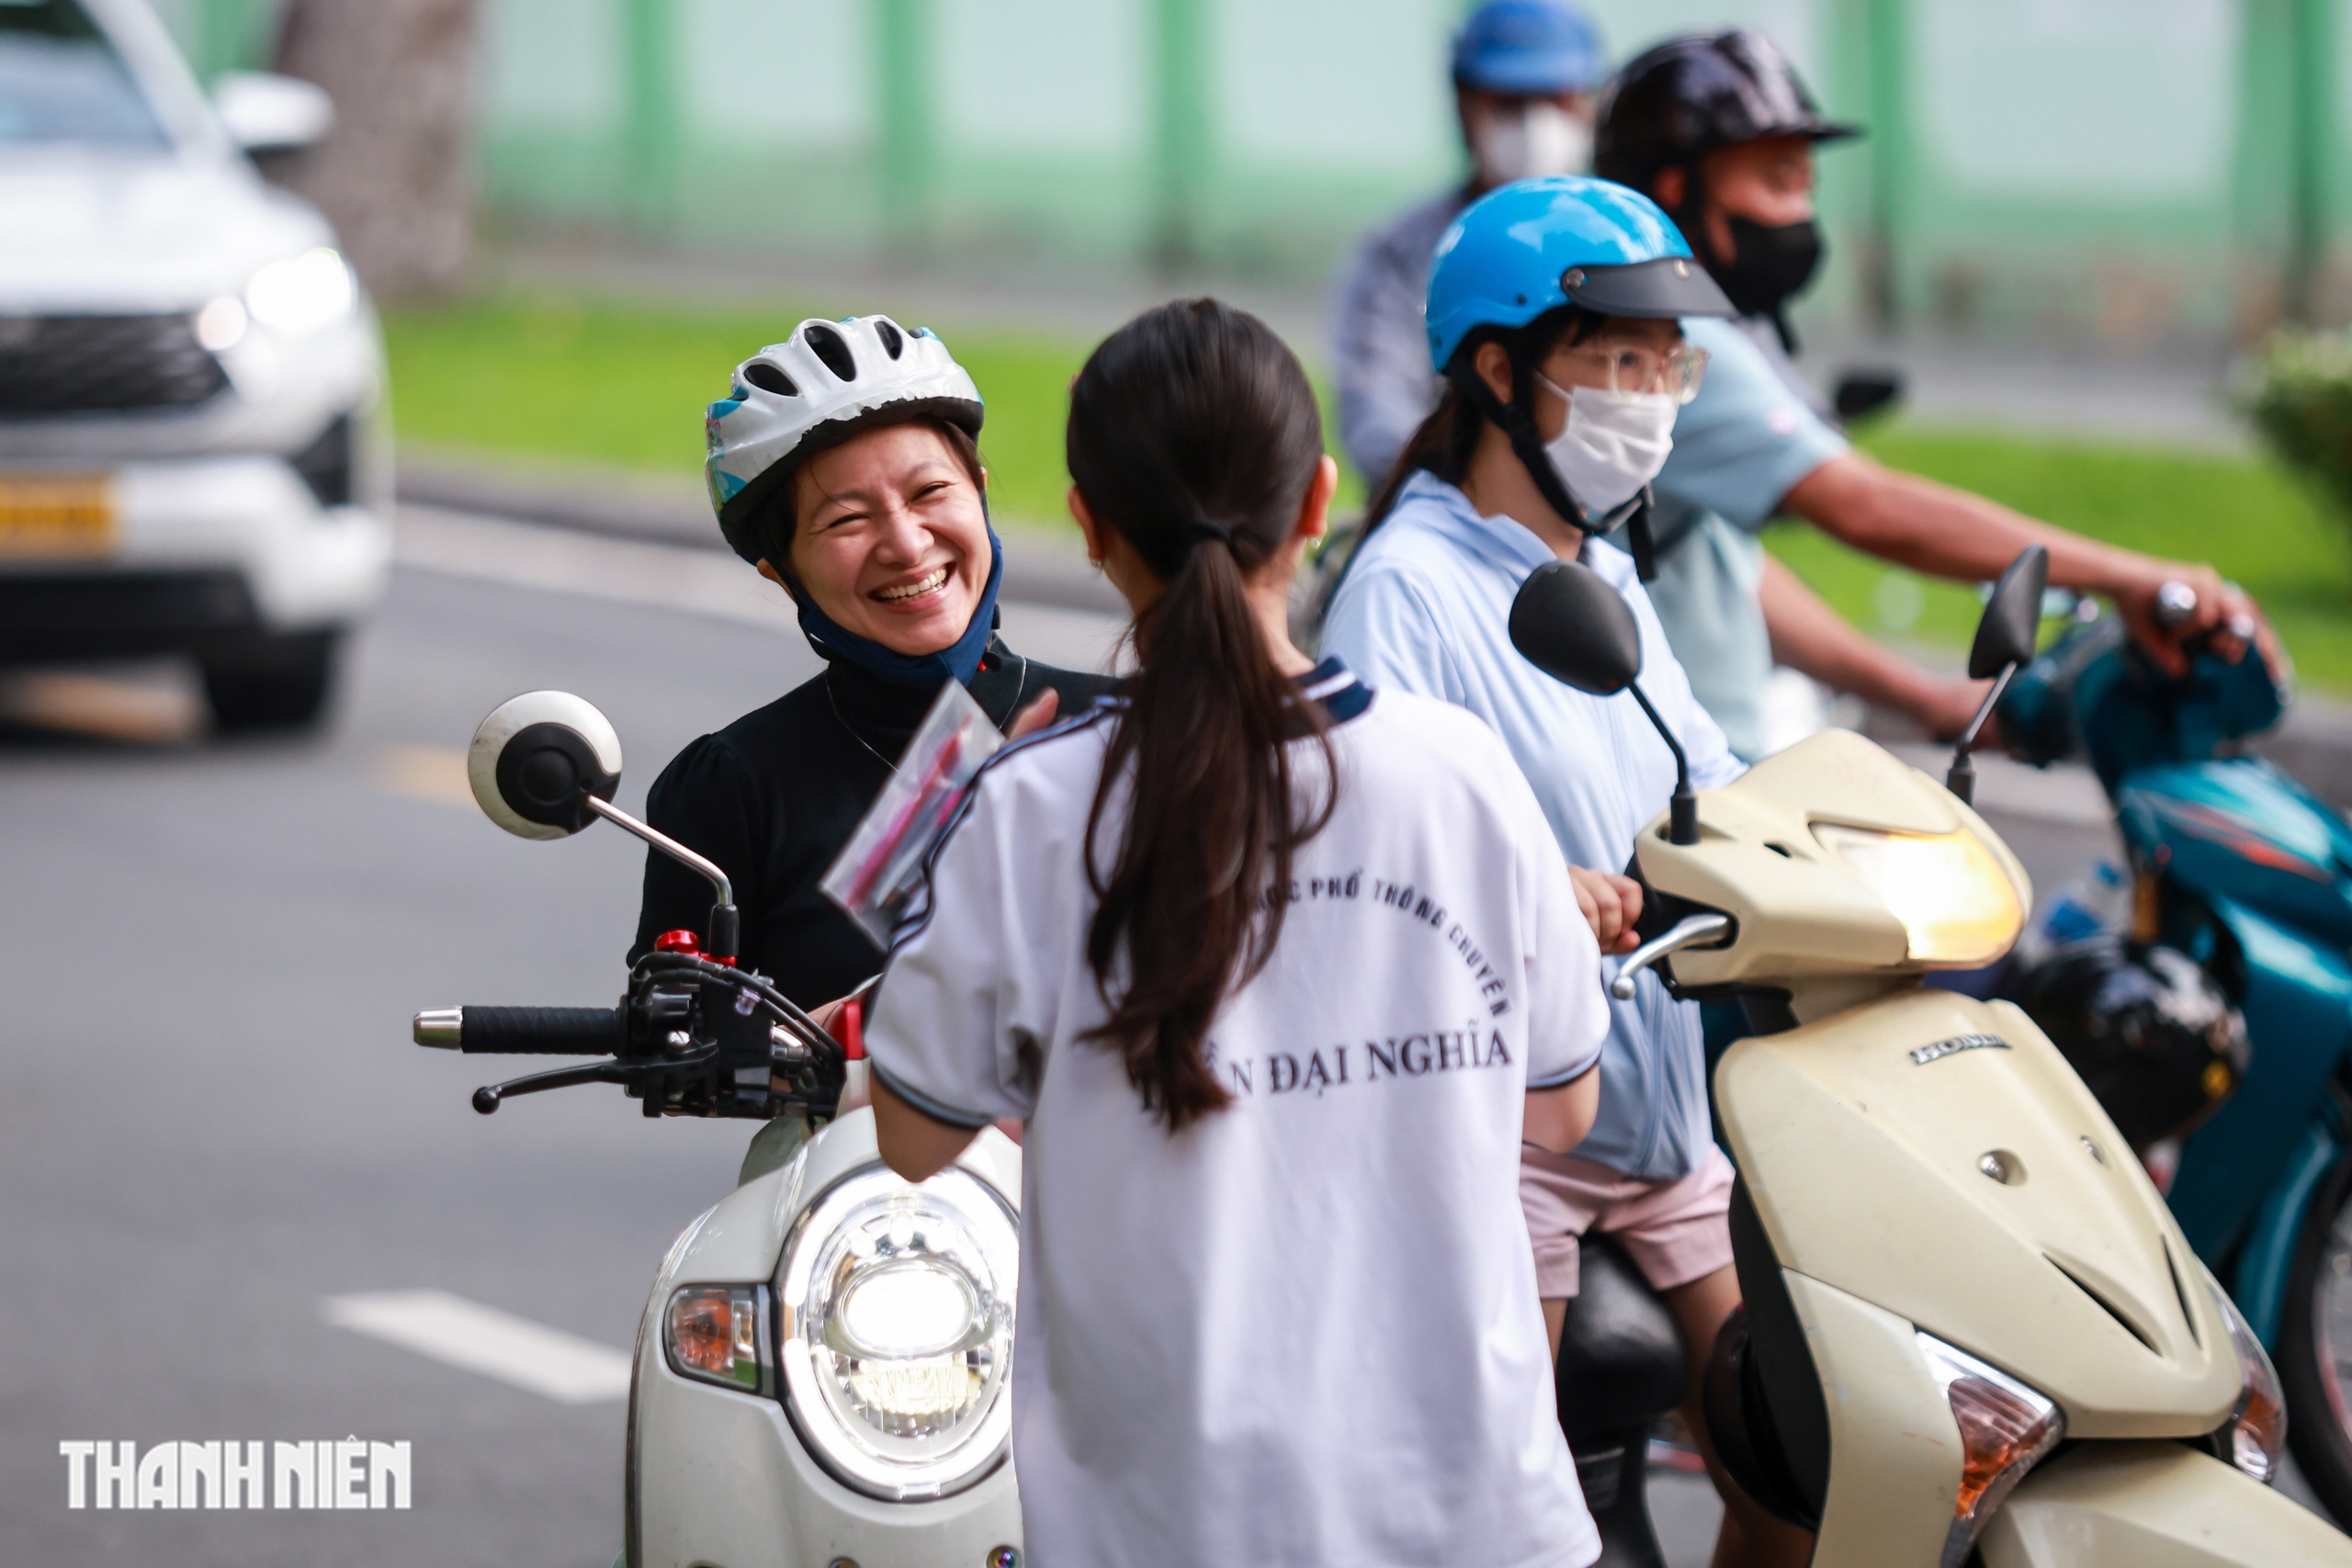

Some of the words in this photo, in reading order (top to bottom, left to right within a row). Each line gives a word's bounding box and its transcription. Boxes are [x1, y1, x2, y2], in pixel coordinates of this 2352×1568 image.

[1374, 878, 1447, 928] THÔNG
[1449, 923, 1511, 1017] CHUYÊN
[1269, 1044, 1351, 1097] ĐẠI
[1366, 1019, 1513, 1081] NGHĨA
